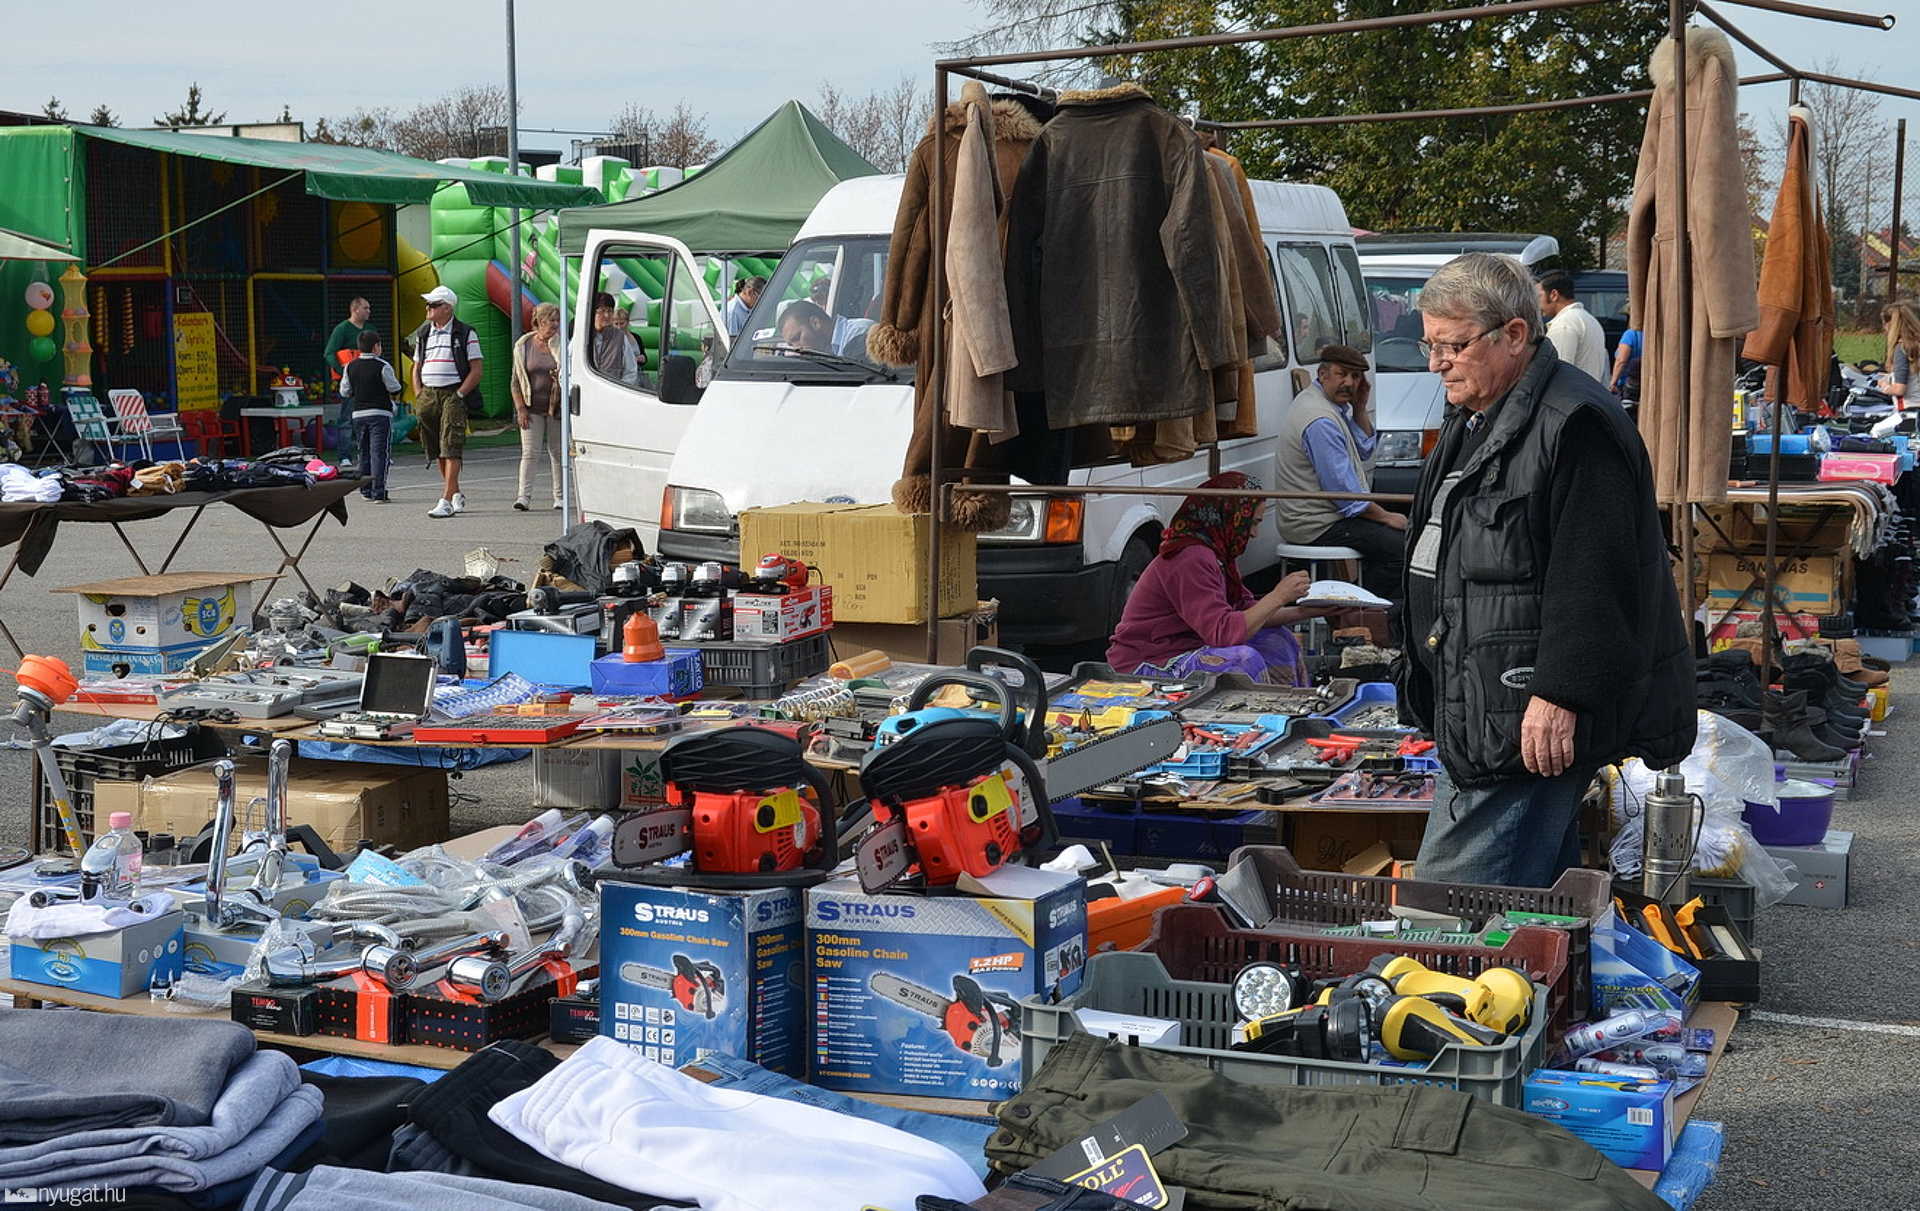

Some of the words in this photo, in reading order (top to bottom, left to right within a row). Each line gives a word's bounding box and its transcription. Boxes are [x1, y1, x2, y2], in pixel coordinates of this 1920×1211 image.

[1736, 561, 1808, 574] BANAS
[638, 823, 676, 849] STRAUS
[873, 838, 899, 870] STRAUS
[635, 902, 710, 923] STRAUS
[757, 896, 804, 922] STRA
[816, 900, 916, 921] STRAUS
[619, 927, 649, 938] 300mm
[686, 934, 710, 945] Chain
[711, 938, 730, 947] Saw
[816, 934, 861, 946] 300mm
[816, 946, 870, 959] Gasoline
[872, 949, 909, 960] Chain
[816, 958, 843, 969] Saw
[899, 986, 939, 1009] STRAUS
[1077, 1164, 1125, 1190] OLL
